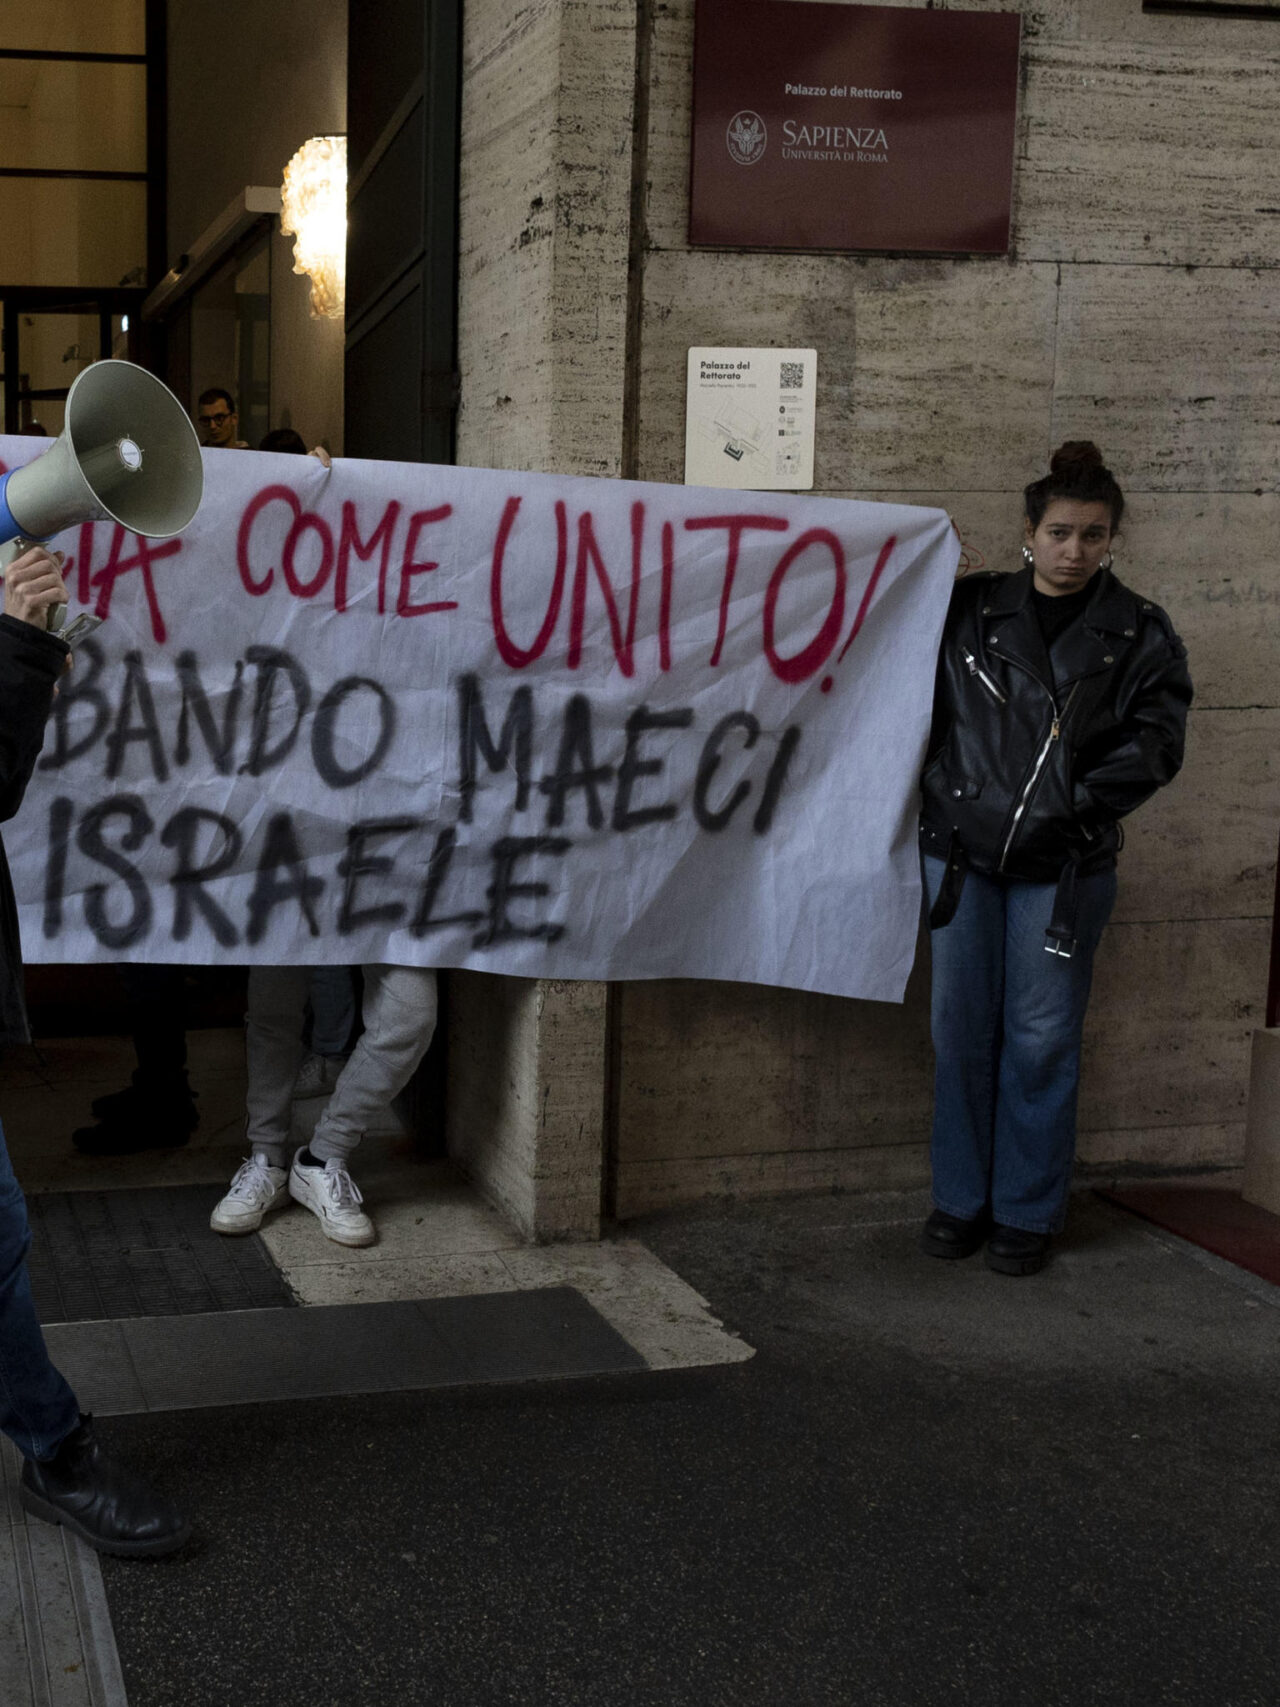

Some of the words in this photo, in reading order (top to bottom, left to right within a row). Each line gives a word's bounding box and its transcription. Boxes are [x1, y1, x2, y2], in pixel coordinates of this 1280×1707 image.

[784, 82, 827, 97] Palazzo
[829, 85, 847, 98] del
[850, 86, 903, 101] Rettorato
[782, 119, 890, 150] SAPIENZA
[856, 150, 889, 163] ROMA
[699, 360, 735, 371] Palazzo
[736, 361, 751, 371] del
[699, 371, 742, 381] Rettorato
[236, 483, 459, 618] COME
[490, 495, 898, 694] UNITO!
[37, 636, 398, 790] BANDO
[455, 668, 803, 838] MAECI
[41, 793, 574, 950] ISRAELE
